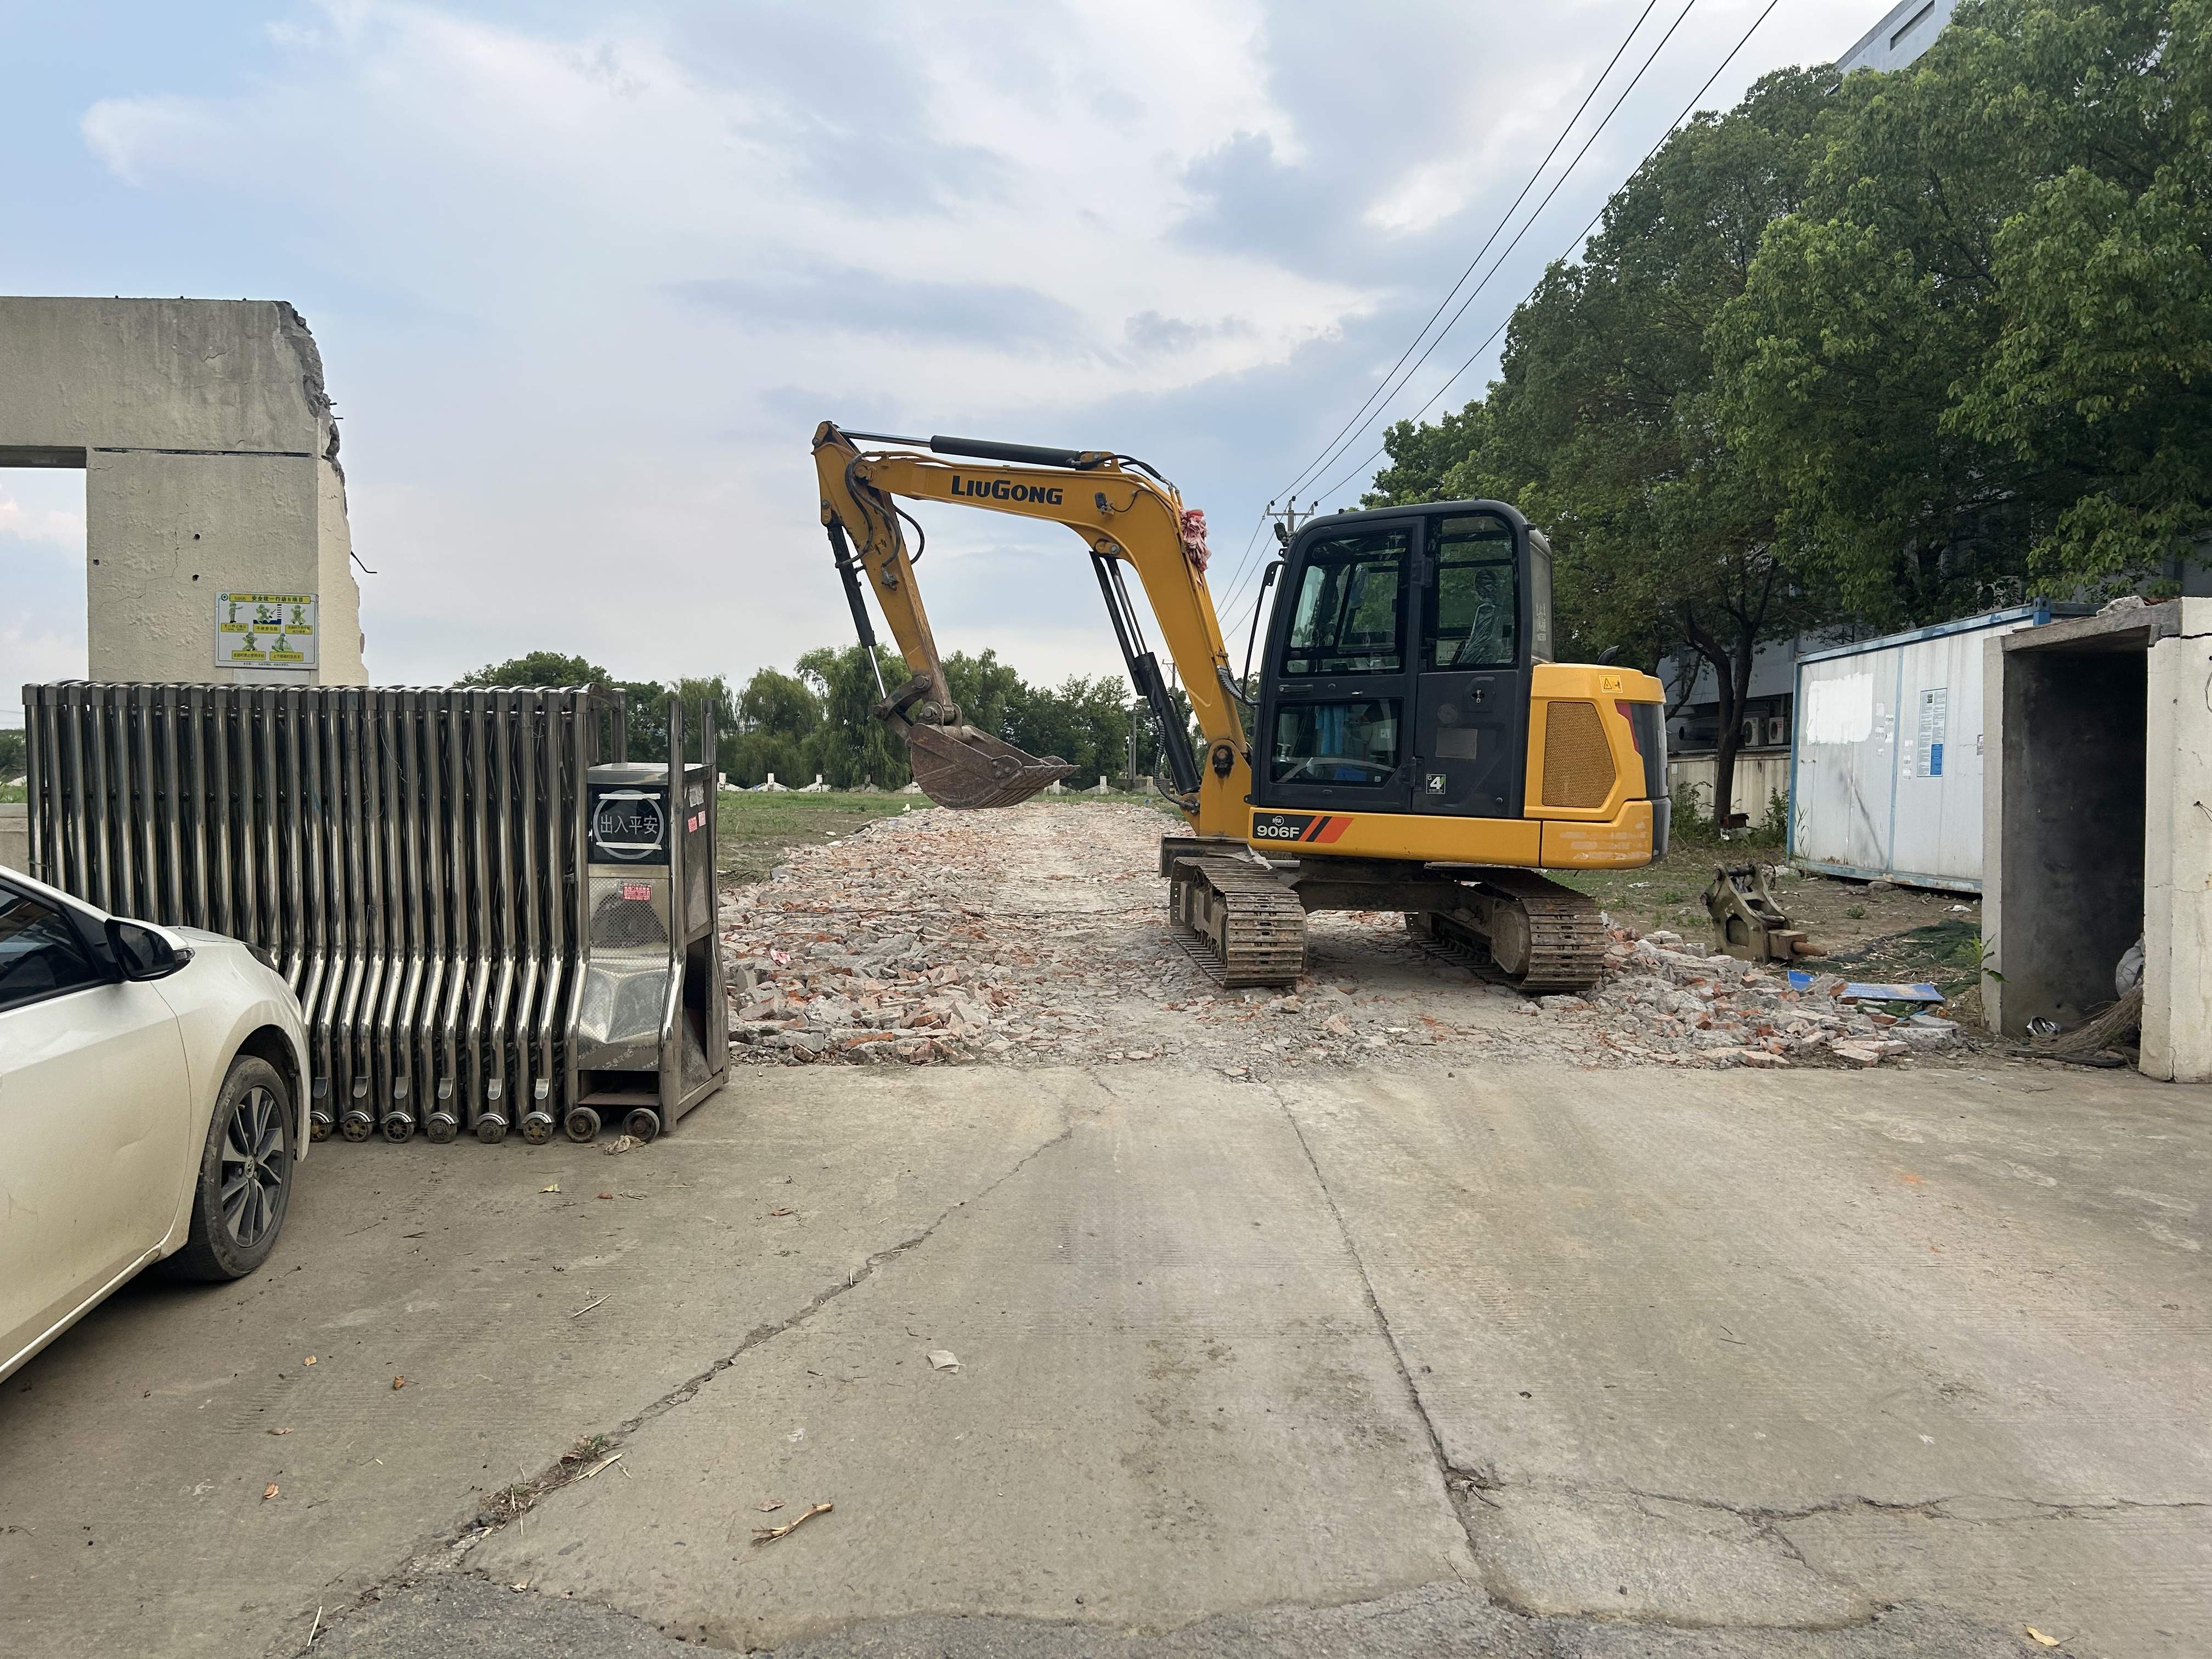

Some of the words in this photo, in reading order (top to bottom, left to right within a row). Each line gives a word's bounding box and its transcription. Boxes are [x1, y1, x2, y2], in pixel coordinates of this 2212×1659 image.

[600, 815, 658, 835] 出入平安
[1257, 825, 1300, 838] 906F
